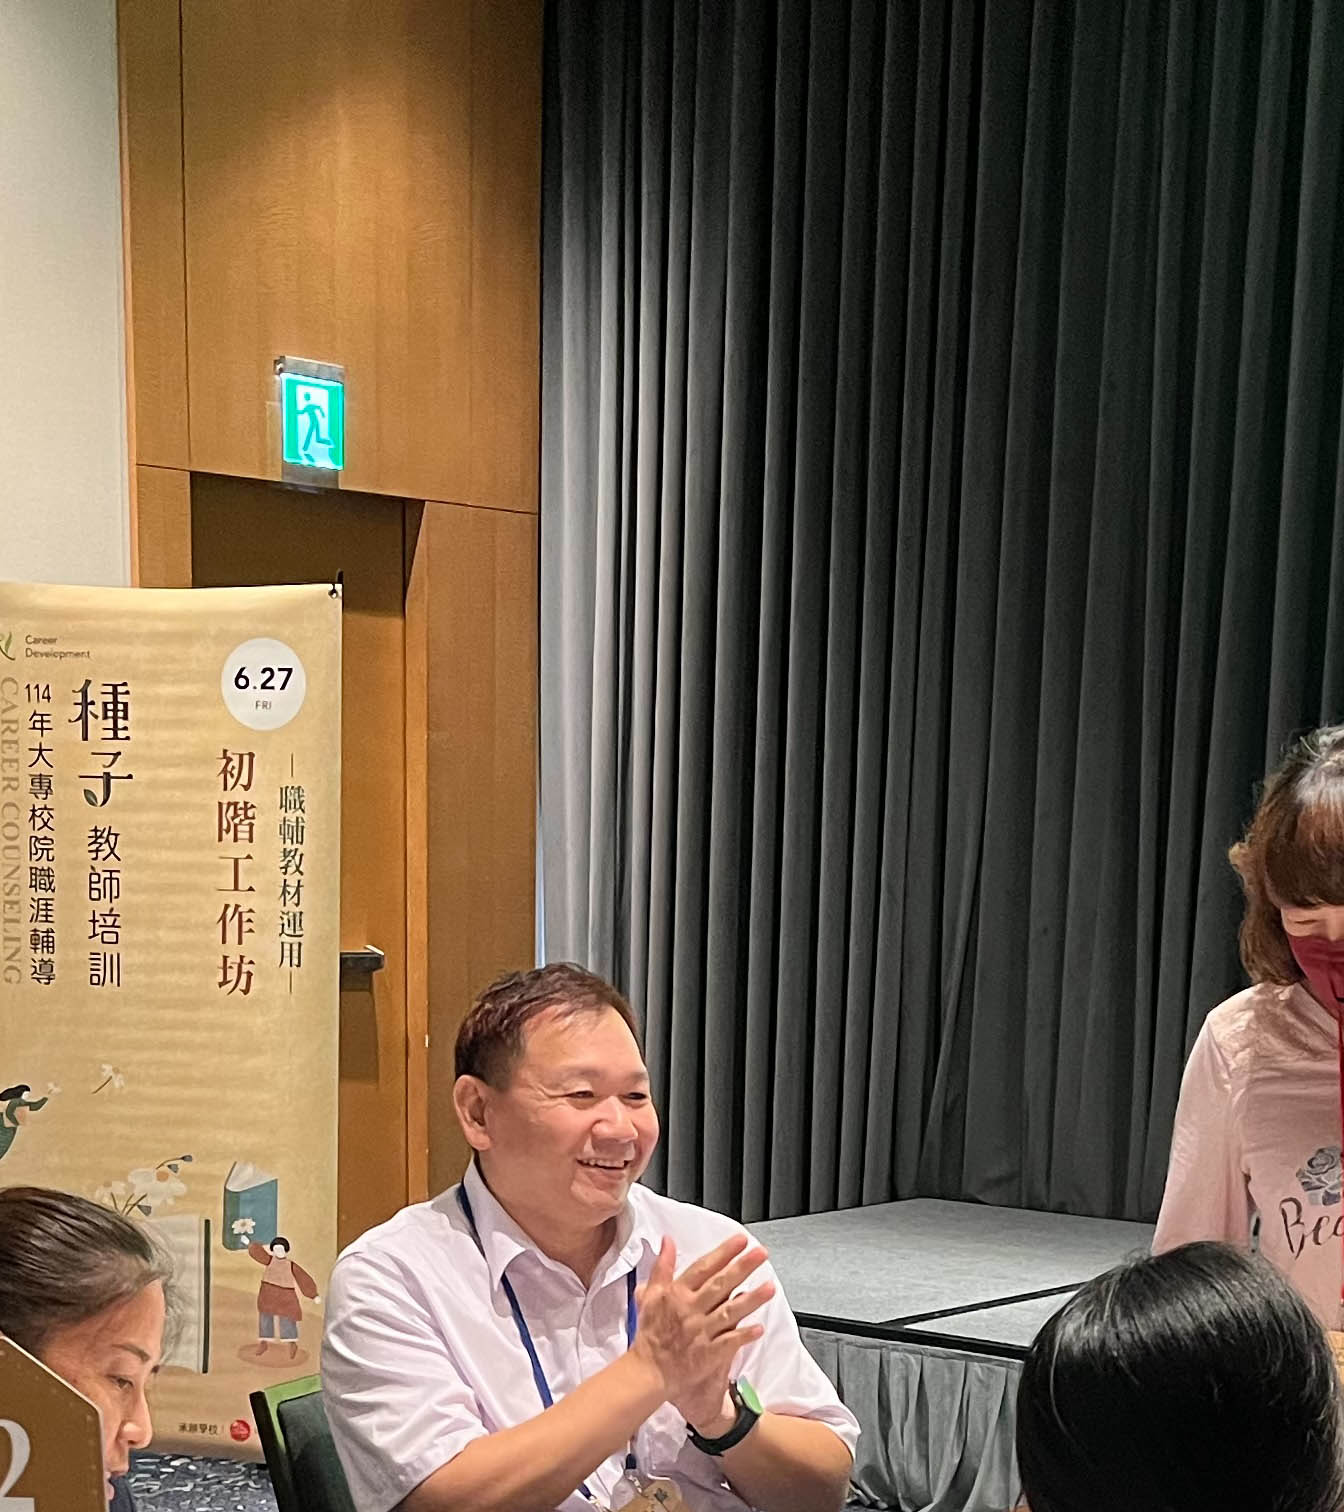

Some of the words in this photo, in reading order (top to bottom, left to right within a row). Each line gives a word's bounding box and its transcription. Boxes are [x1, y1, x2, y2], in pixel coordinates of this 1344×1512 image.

[24, 647, 91, 661] Development
[233, 667, 294, 692] 6.27
[0, 677, 21, 793] CAREER
[254, 700, 273, 711] FRI
[0, 801, 24, 987] COUNSELING
[215, 748, 257, 997] 初階工作坊
